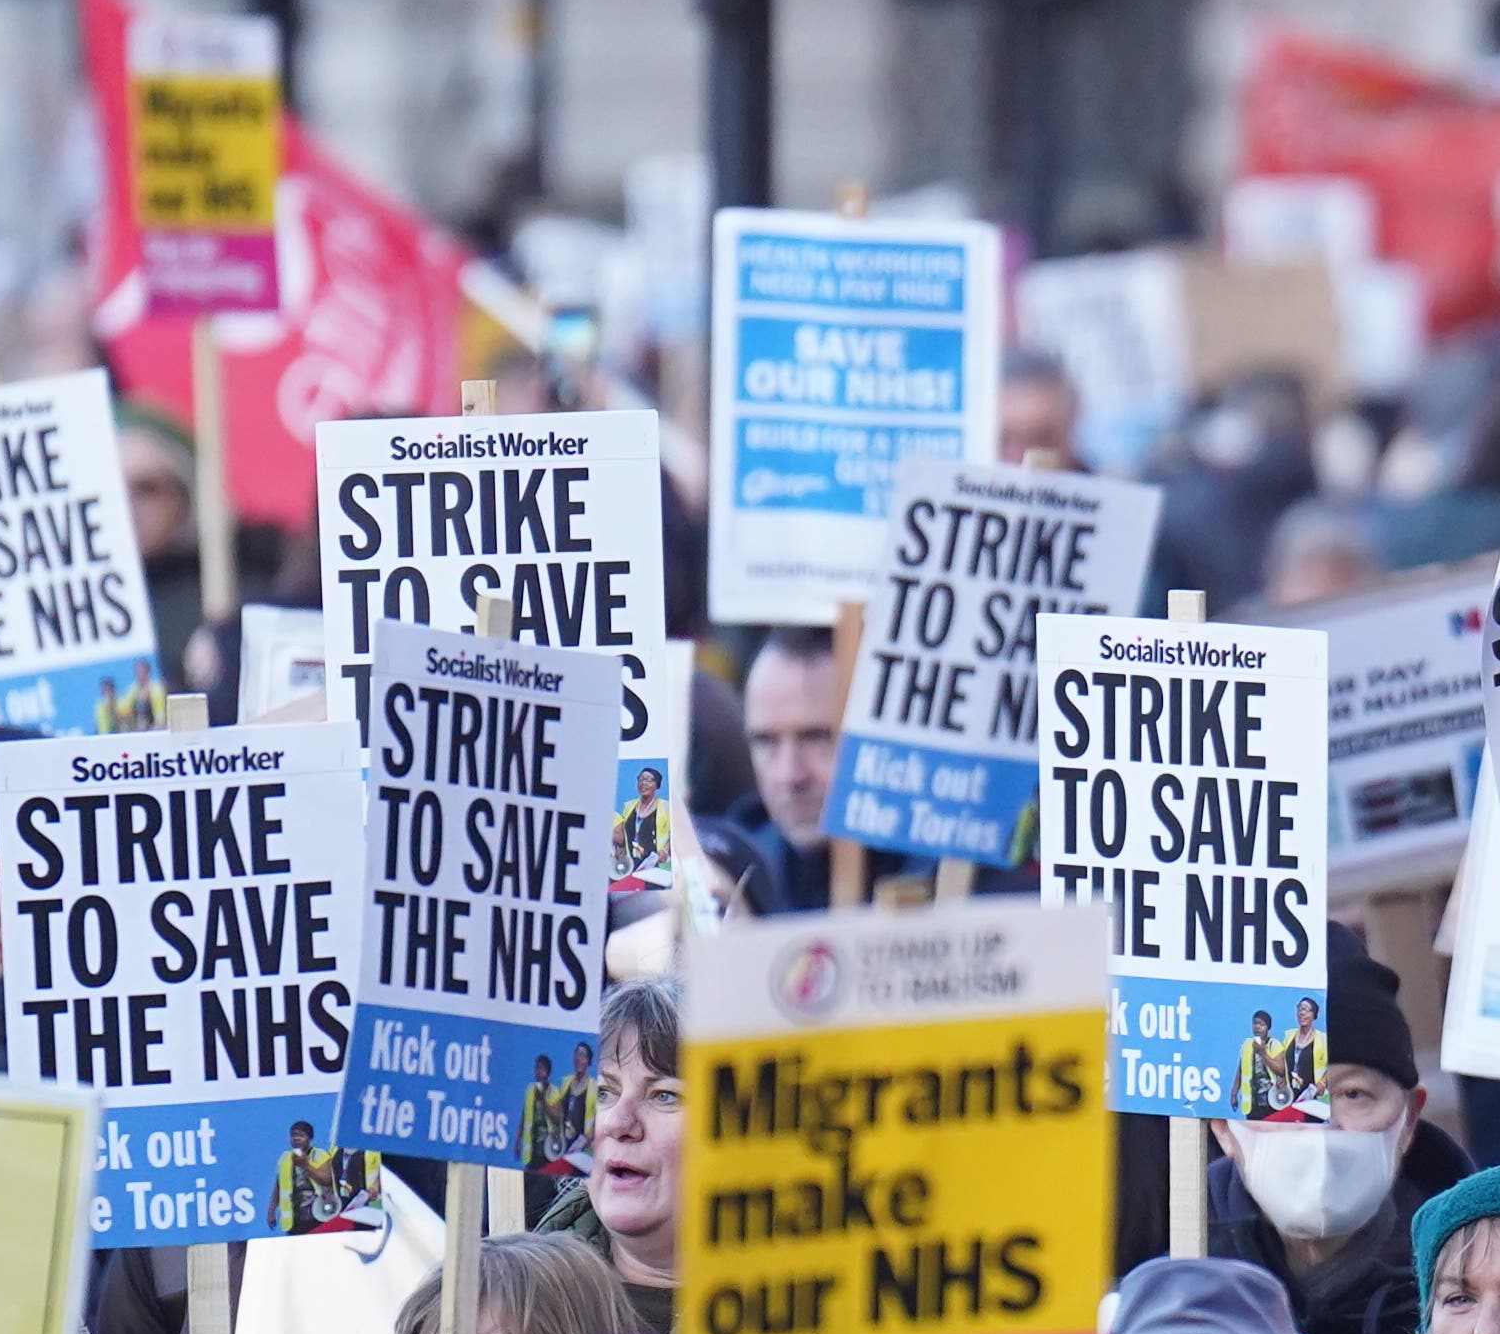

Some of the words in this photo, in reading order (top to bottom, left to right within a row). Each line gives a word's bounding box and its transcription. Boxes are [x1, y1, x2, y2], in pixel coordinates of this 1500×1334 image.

[794, 325, 905, 366] SAVE
[746, 361, 833, 404] OUR
[843, 368, 954, 412] NHS!
[389, 431, 496, 461] Socialist
[499, 431, 588, 458] Worker
[425, 648, 502, 684] Socialist
[503, 661, 564, 694] Worker
[1100, 634, 1184, 665] Socialist
[1188, 641, 1266, 669] Worker
[71, 752, 187, 784] Socialist
[190, 747, 284, 775] Worker
[930, 765, 988, 803] out
[1139, 995, 1191, 1040] out
[371, 1018, 437, 1076] Kick
[444, 1033, 491, 1085] out
[1121, 1049, 1221, 1102] Tories
[360, 1088, 412, 1137] the
[428, 1093, 508, 1152] Tories
[711, 1041, 1087, 1158] Migrants
[146, 1118, 217, 1167] out
[126, 1181, 256, 1231] Tories
[708, 1139, 933, 1246] make
[869, 1235, 1046, 1327] NHS
